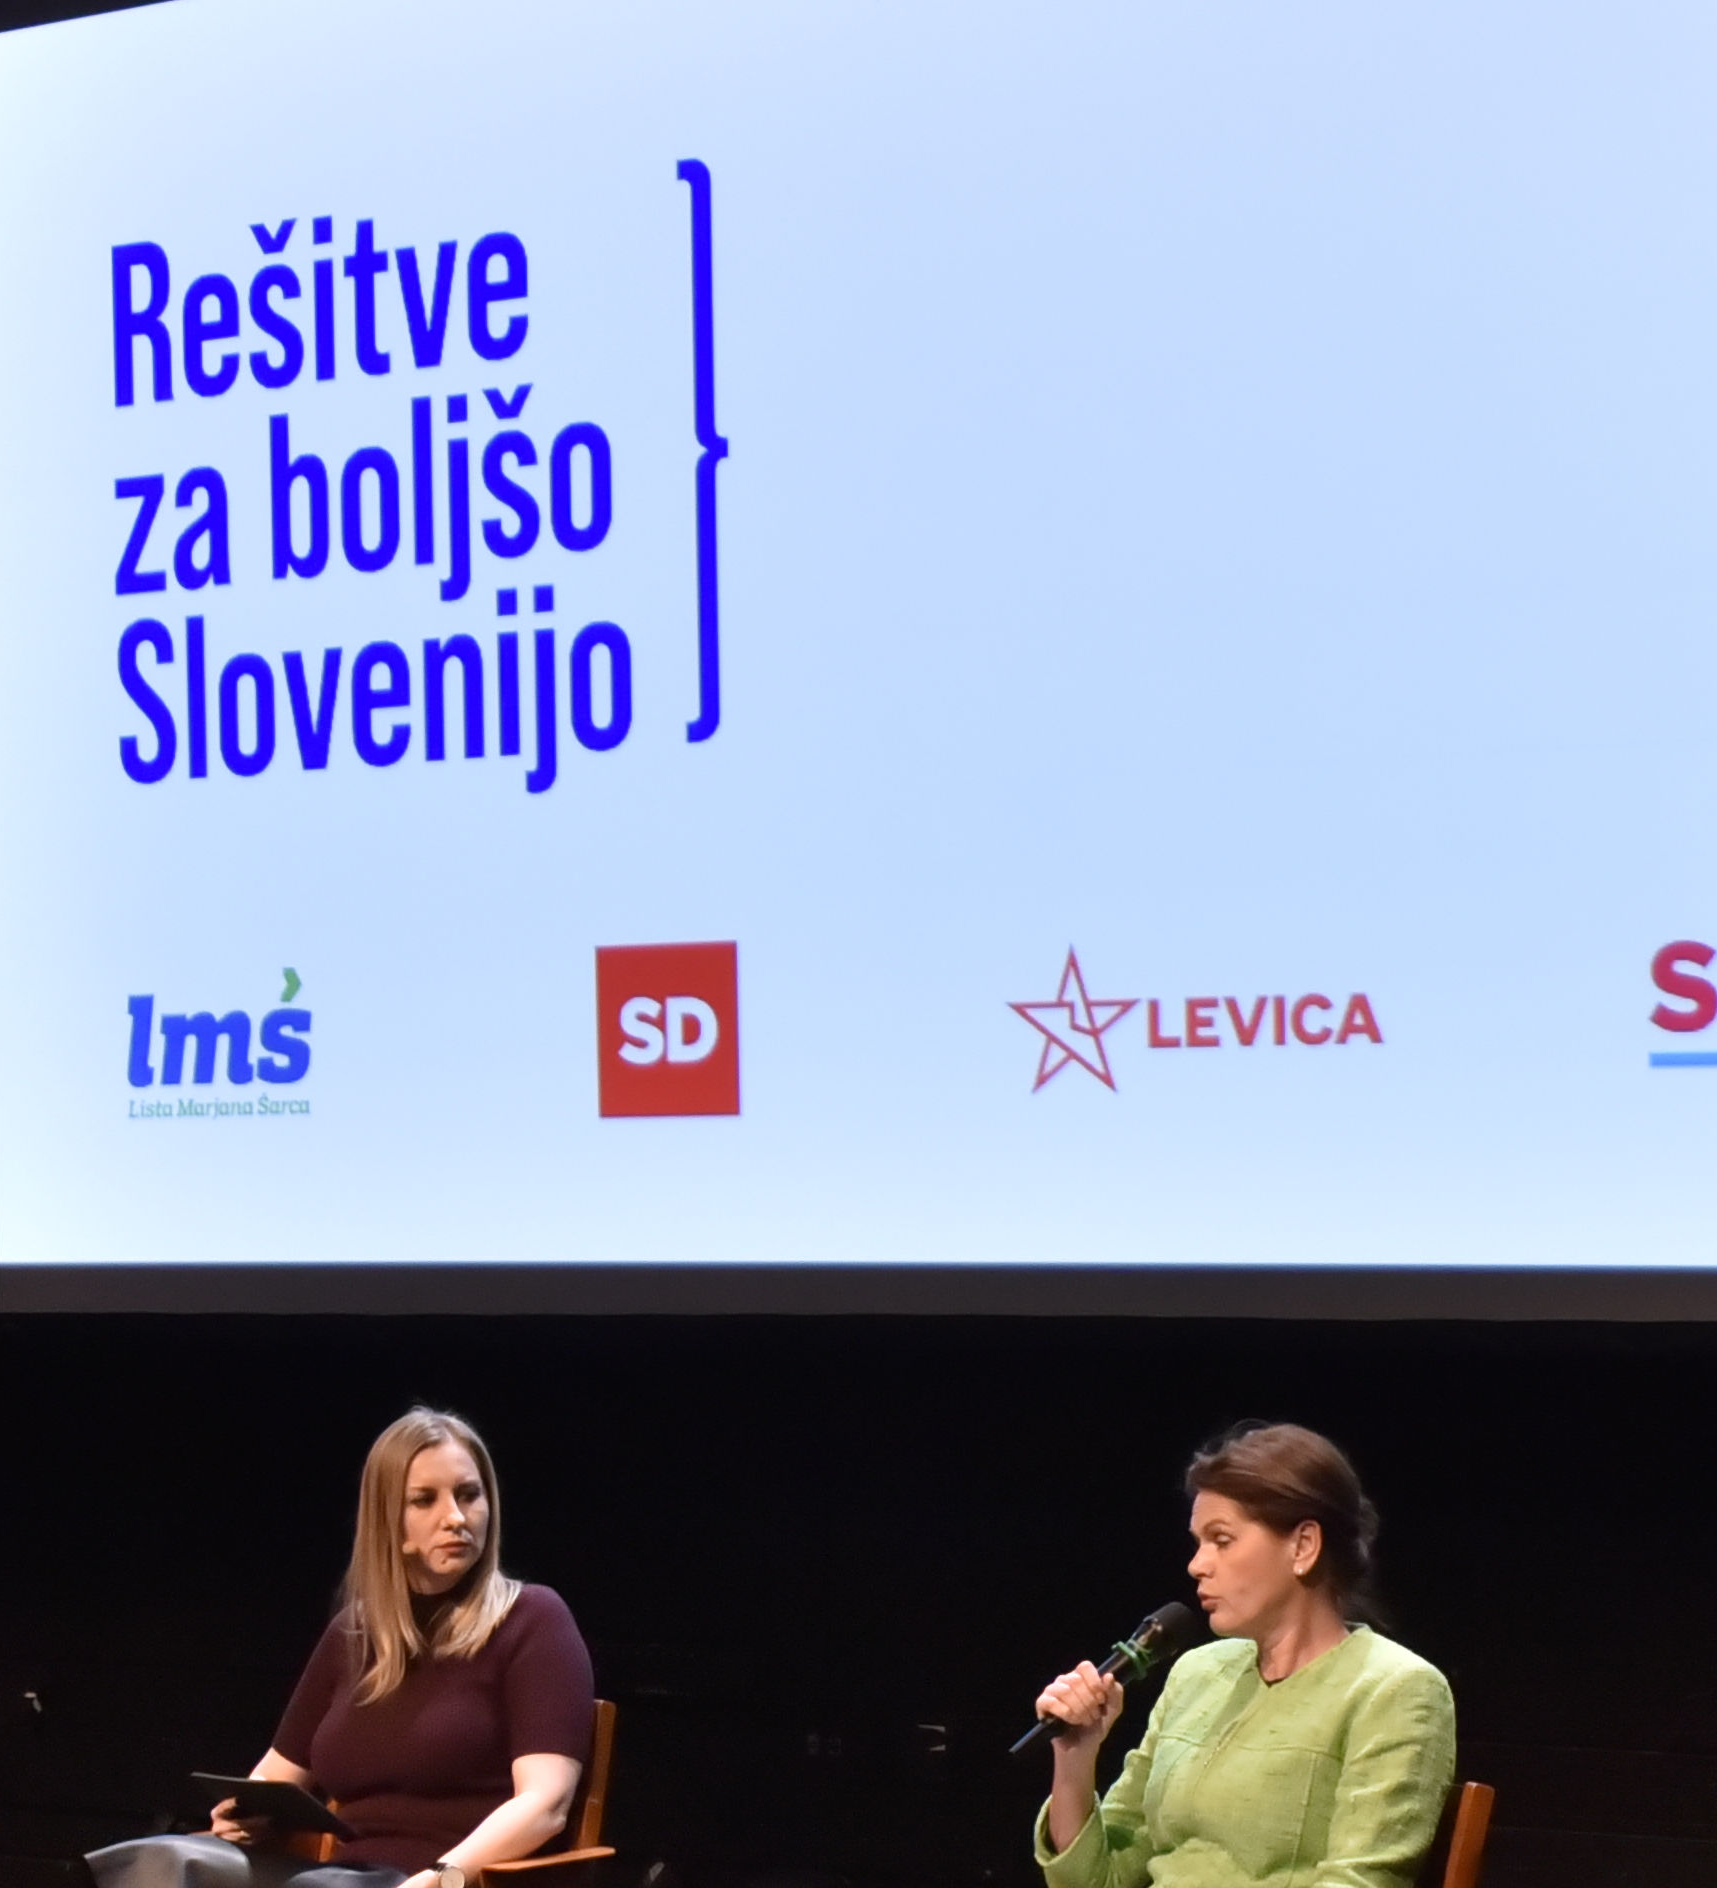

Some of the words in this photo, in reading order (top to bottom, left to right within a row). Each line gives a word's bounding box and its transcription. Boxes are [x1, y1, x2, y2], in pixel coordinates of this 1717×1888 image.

[110, 214, 530, 409] Rešitve
[114, 465, 232, 597] za
[268, 383, 614, 603] boljšo
[116, 584, 634, 795] Slovenijo
[617, 995, 720, 1066] SD
[1147, 992, 1385, 1050] LEVICA
[128, 1098, 173, 1119] Lista
[176, 1097, 254, 1120] Marjana
[256, 1092, 311, 1116] Šarca
